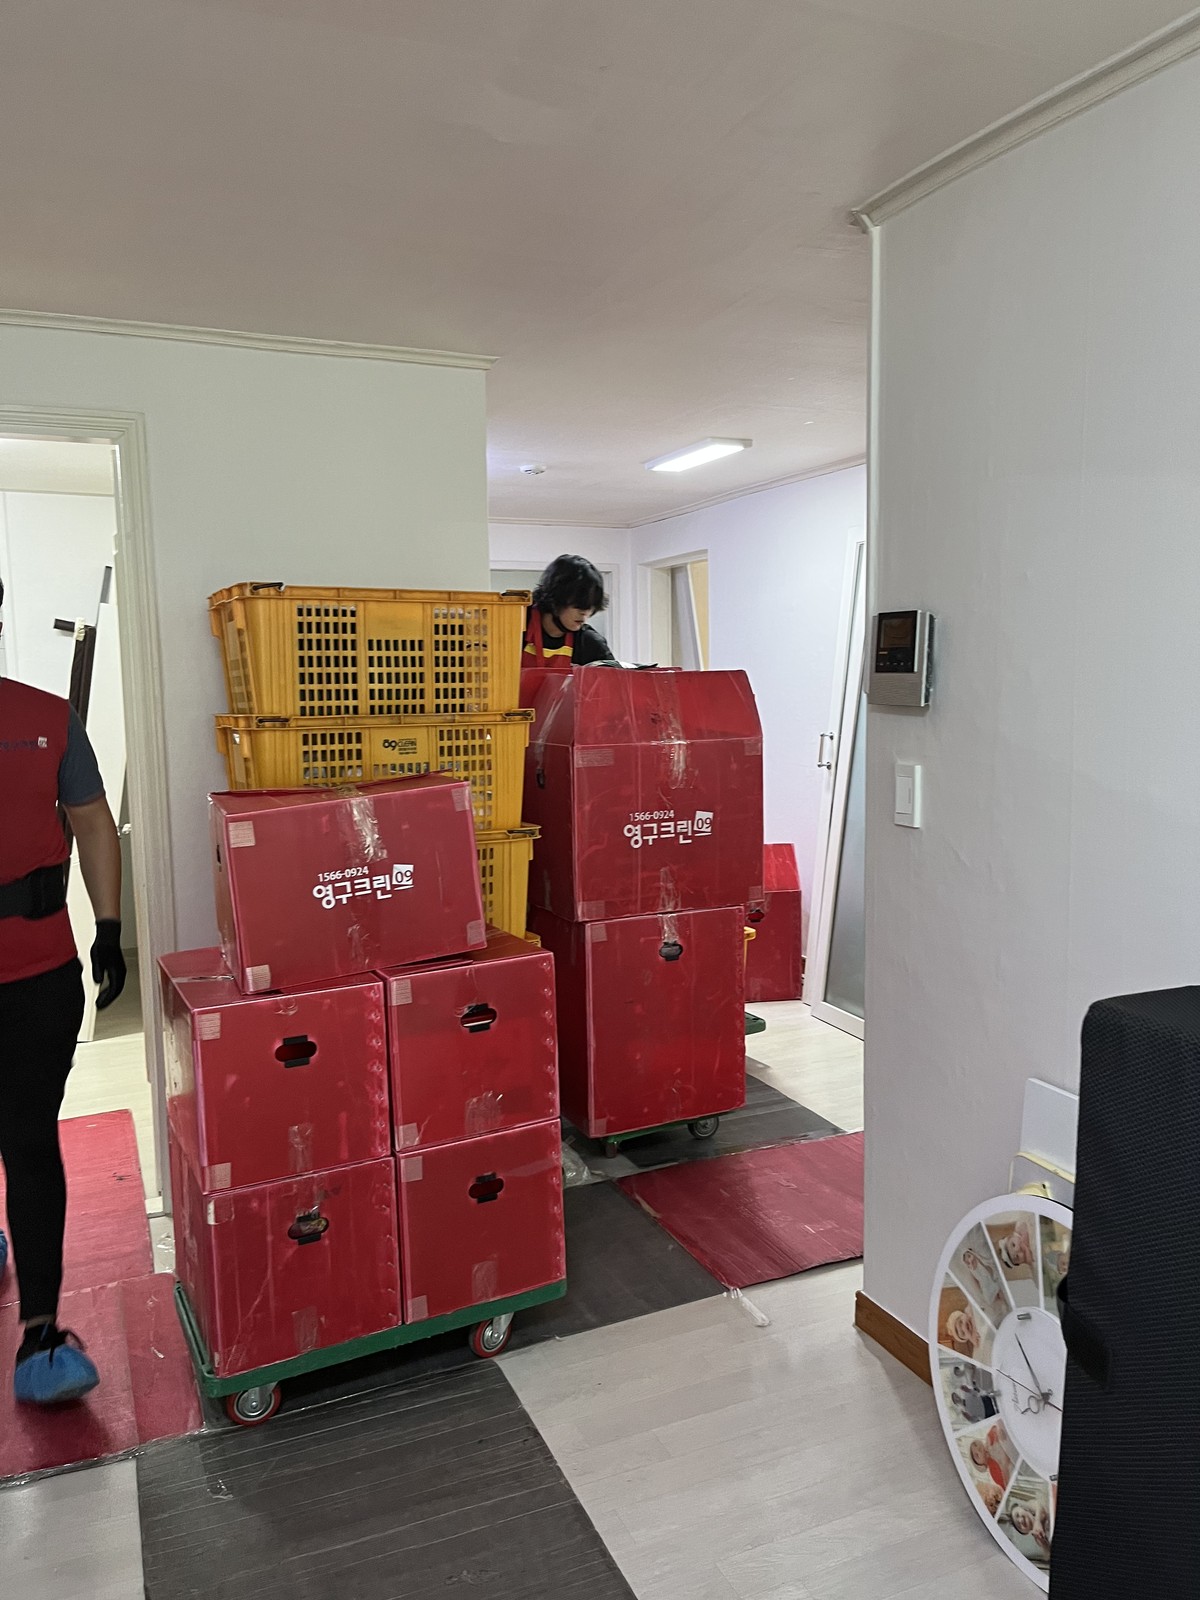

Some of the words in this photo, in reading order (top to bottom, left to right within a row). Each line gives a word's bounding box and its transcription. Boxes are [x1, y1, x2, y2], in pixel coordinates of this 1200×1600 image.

[629, 809, 675, 821] 1566-0924
[623, 820, 693, 849] 영구크린
[317, 866, 369, 882] 1566-0924
[312, 874, 393, 909] 영구크린
